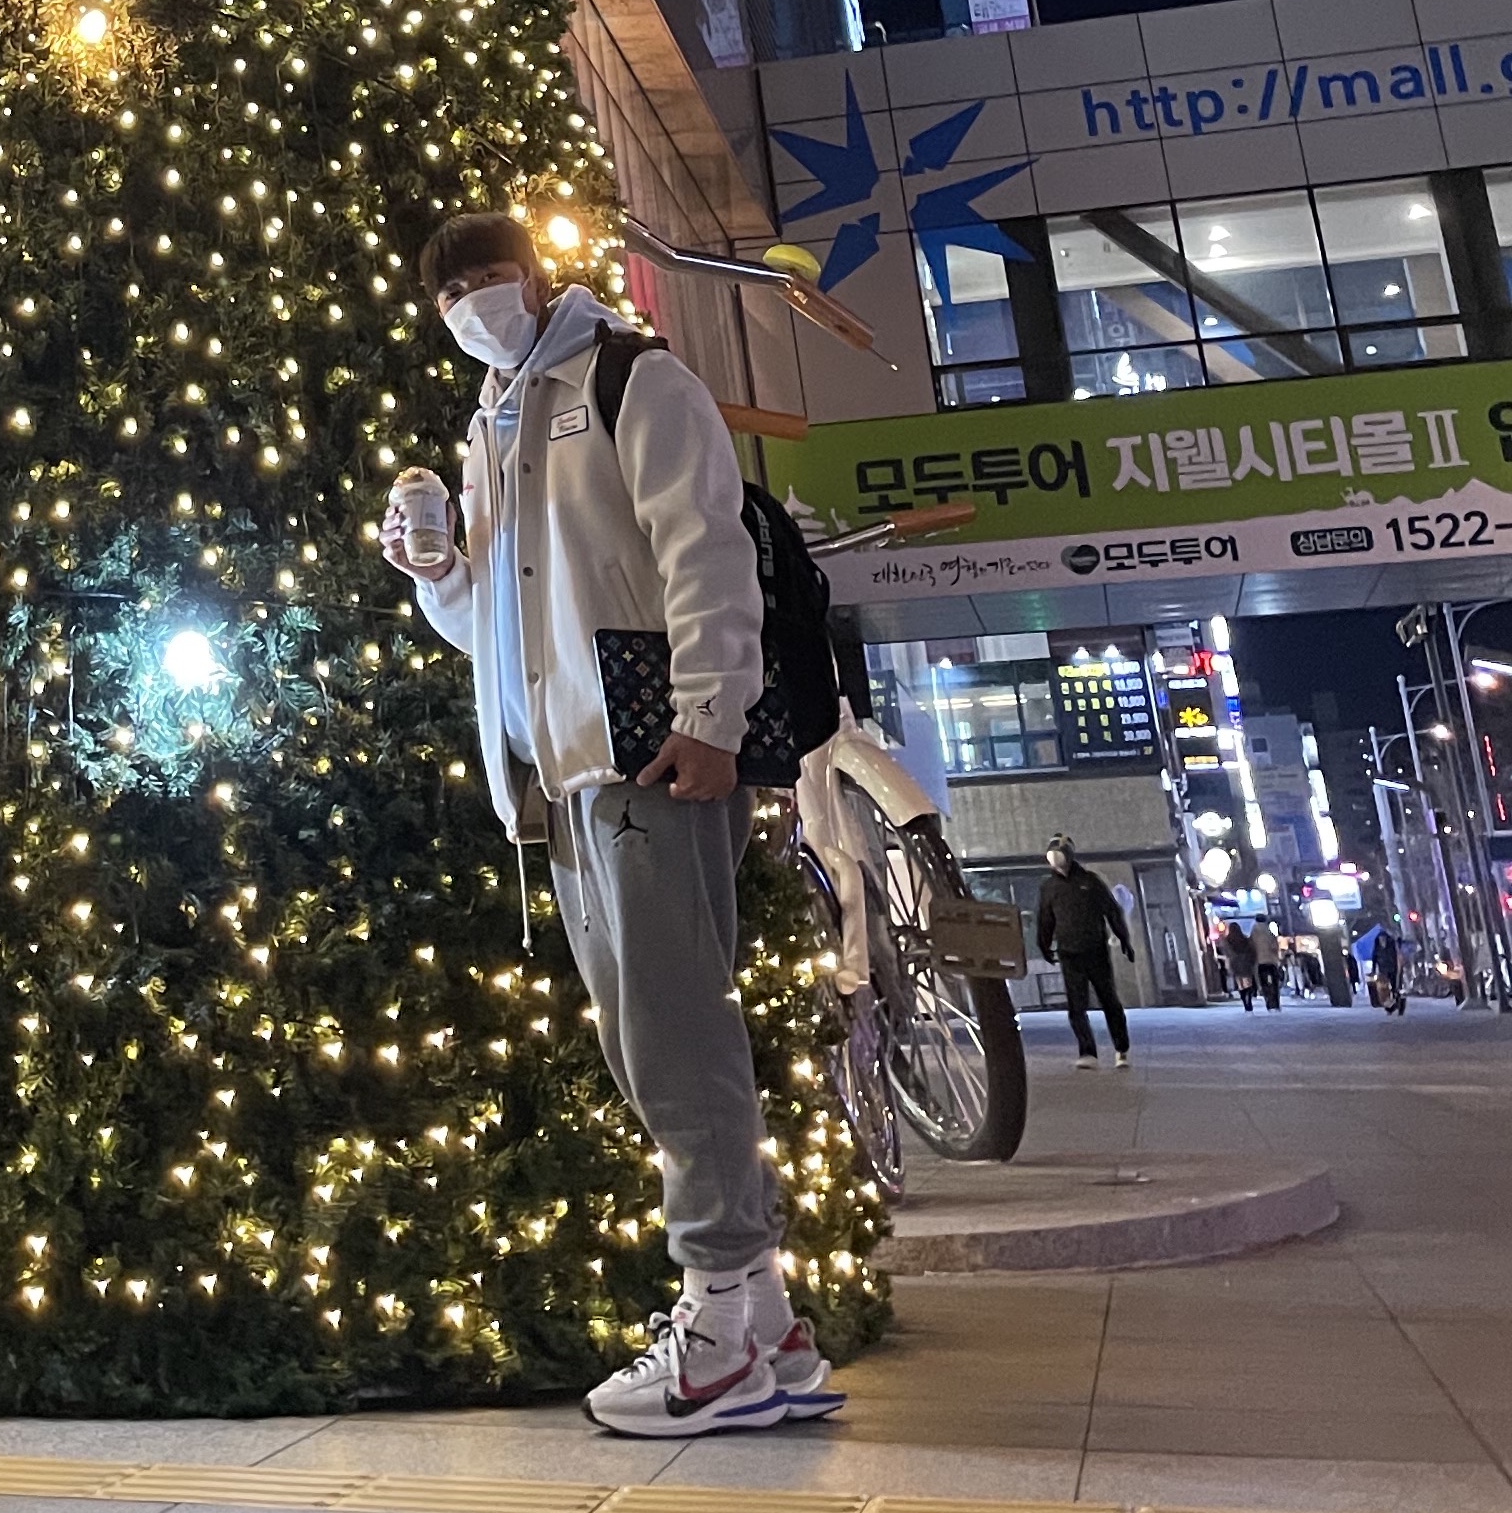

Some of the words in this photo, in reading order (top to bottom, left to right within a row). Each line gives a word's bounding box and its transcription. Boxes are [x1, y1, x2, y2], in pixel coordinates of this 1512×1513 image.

[856, 439, 1092, 515] 모두투어
[1104, 535, 1239, 571] 모두투어
[1296, 528, 1368, 553] 상담문의
